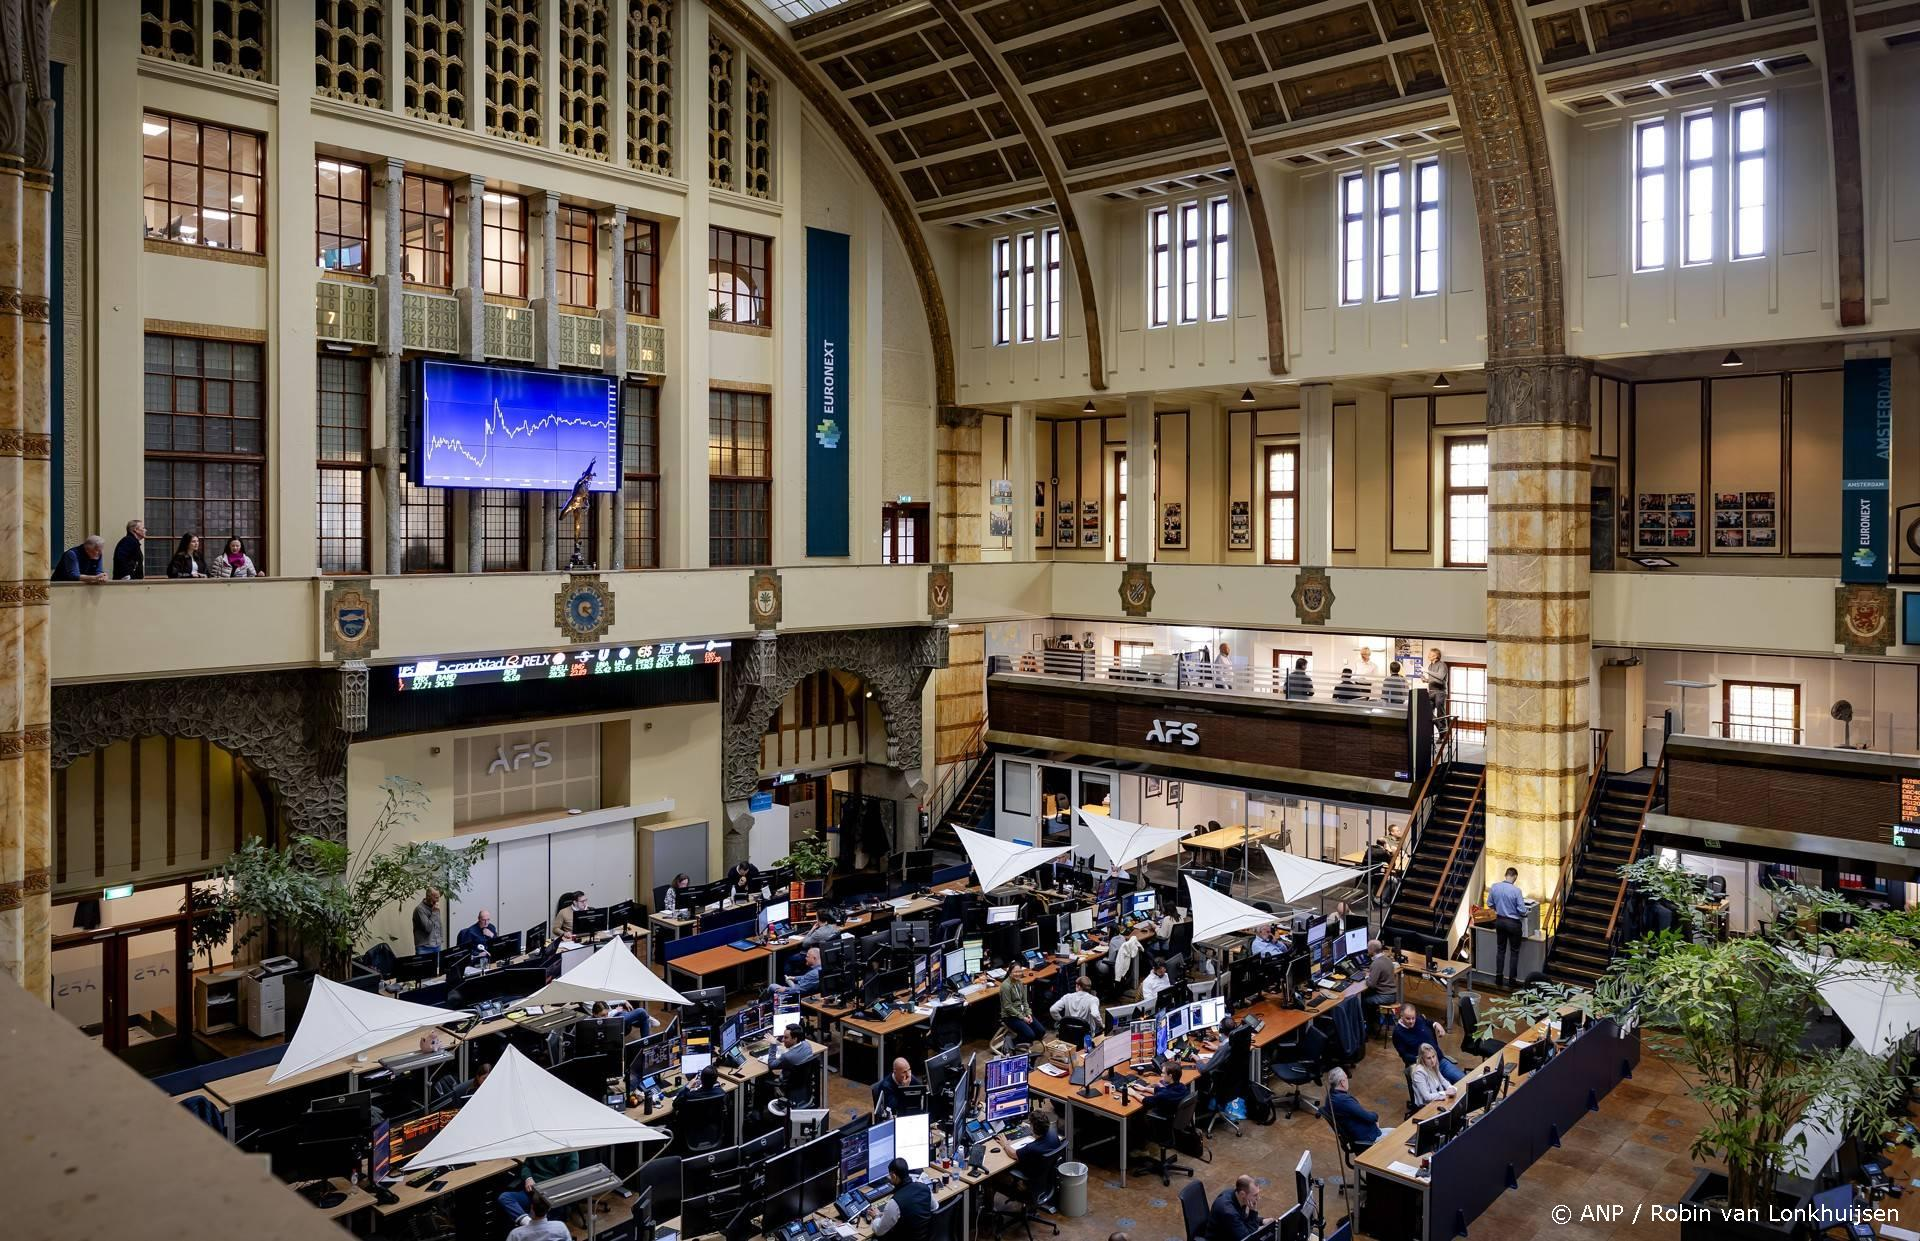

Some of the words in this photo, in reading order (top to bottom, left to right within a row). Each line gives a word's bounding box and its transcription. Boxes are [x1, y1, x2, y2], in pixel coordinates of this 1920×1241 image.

[348, 288, 354, 298] 9
[346, 300, 356, 312] 10
[328, 312, 336, 324] 7
[506, 308, 516, 320] 41
[346, 328, 356, 340] 12
[824, 340, 834, 414] EURONEXT
[1876, 368, 1892, 460] AMSTERDAM
[1860, 499, 1871, 545] EURONEXT
[522, 652, 551, 666] RELX
[1146, 719, 1200, 746] AFS
[488, 741, 552, 774] AFS
